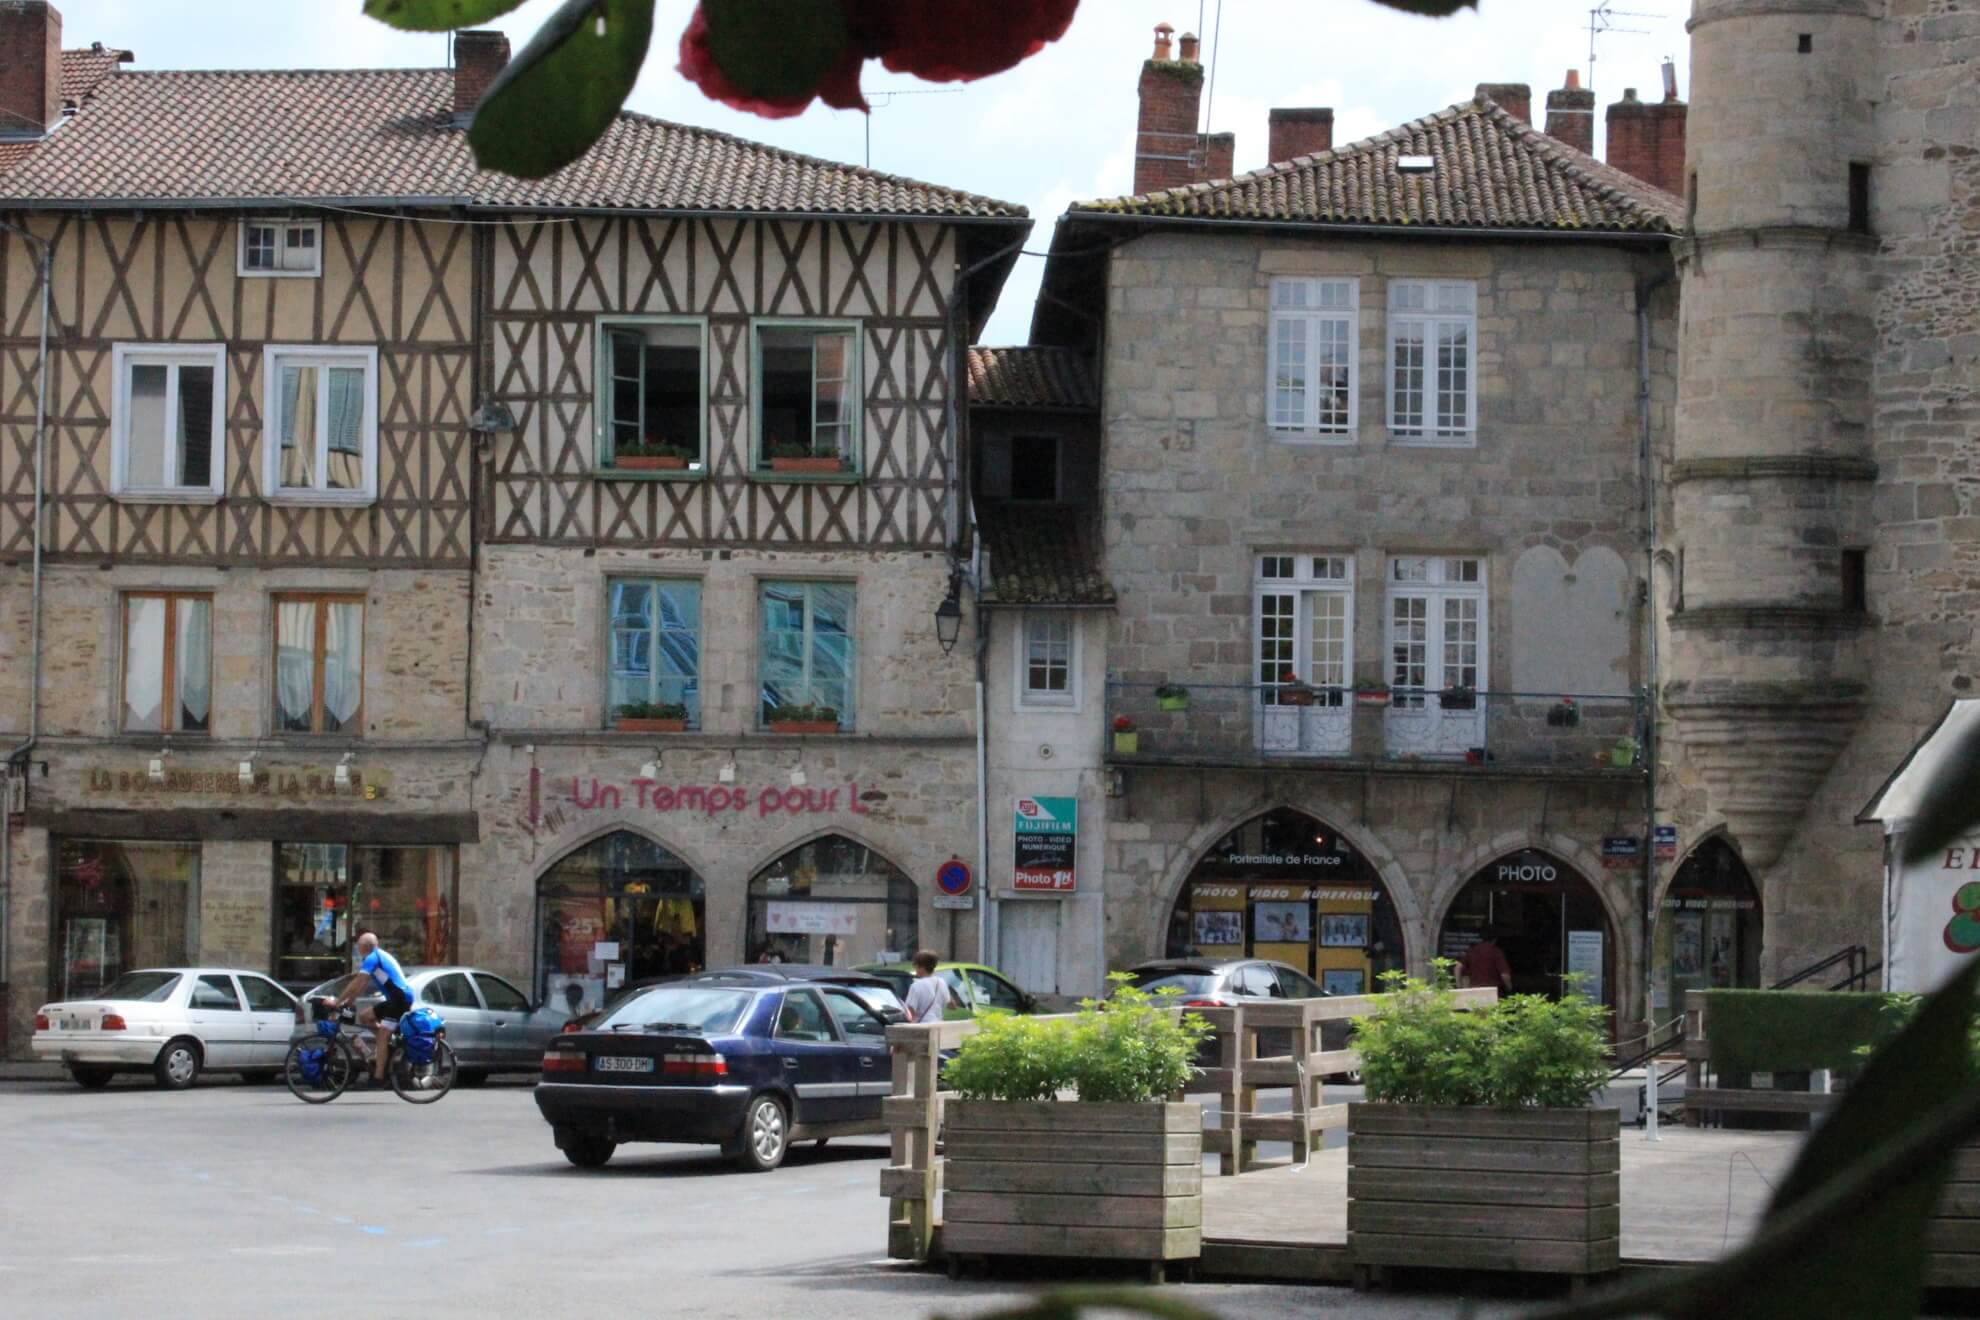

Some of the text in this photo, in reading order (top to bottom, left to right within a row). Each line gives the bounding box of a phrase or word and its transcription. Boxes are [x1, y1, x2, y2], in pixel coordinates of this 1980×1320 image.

[90, 768, 113, 791] LA
[119, 770, 241, 794] BOANGERIE
[278, 773, 299, 794] LA
[306, 773, 362, 795] PLAE
[572, 776, 621, 810] Un
[631, 778, 747, 816] Temps
[759, 785, 839, 818] pour
[1018, 821, 1072, 831] FUJIFILM
[1017, 835, 1043, 844] PHOTO
[1229, 854, 1341, 865] Portraitiste de France
[1015, 871, 1052, 885] Photo
[1499, 865, 1557, 881] PHOTO
[1192, 887, 1380, 901] PHOTO VIDEO NUMERIQUE
